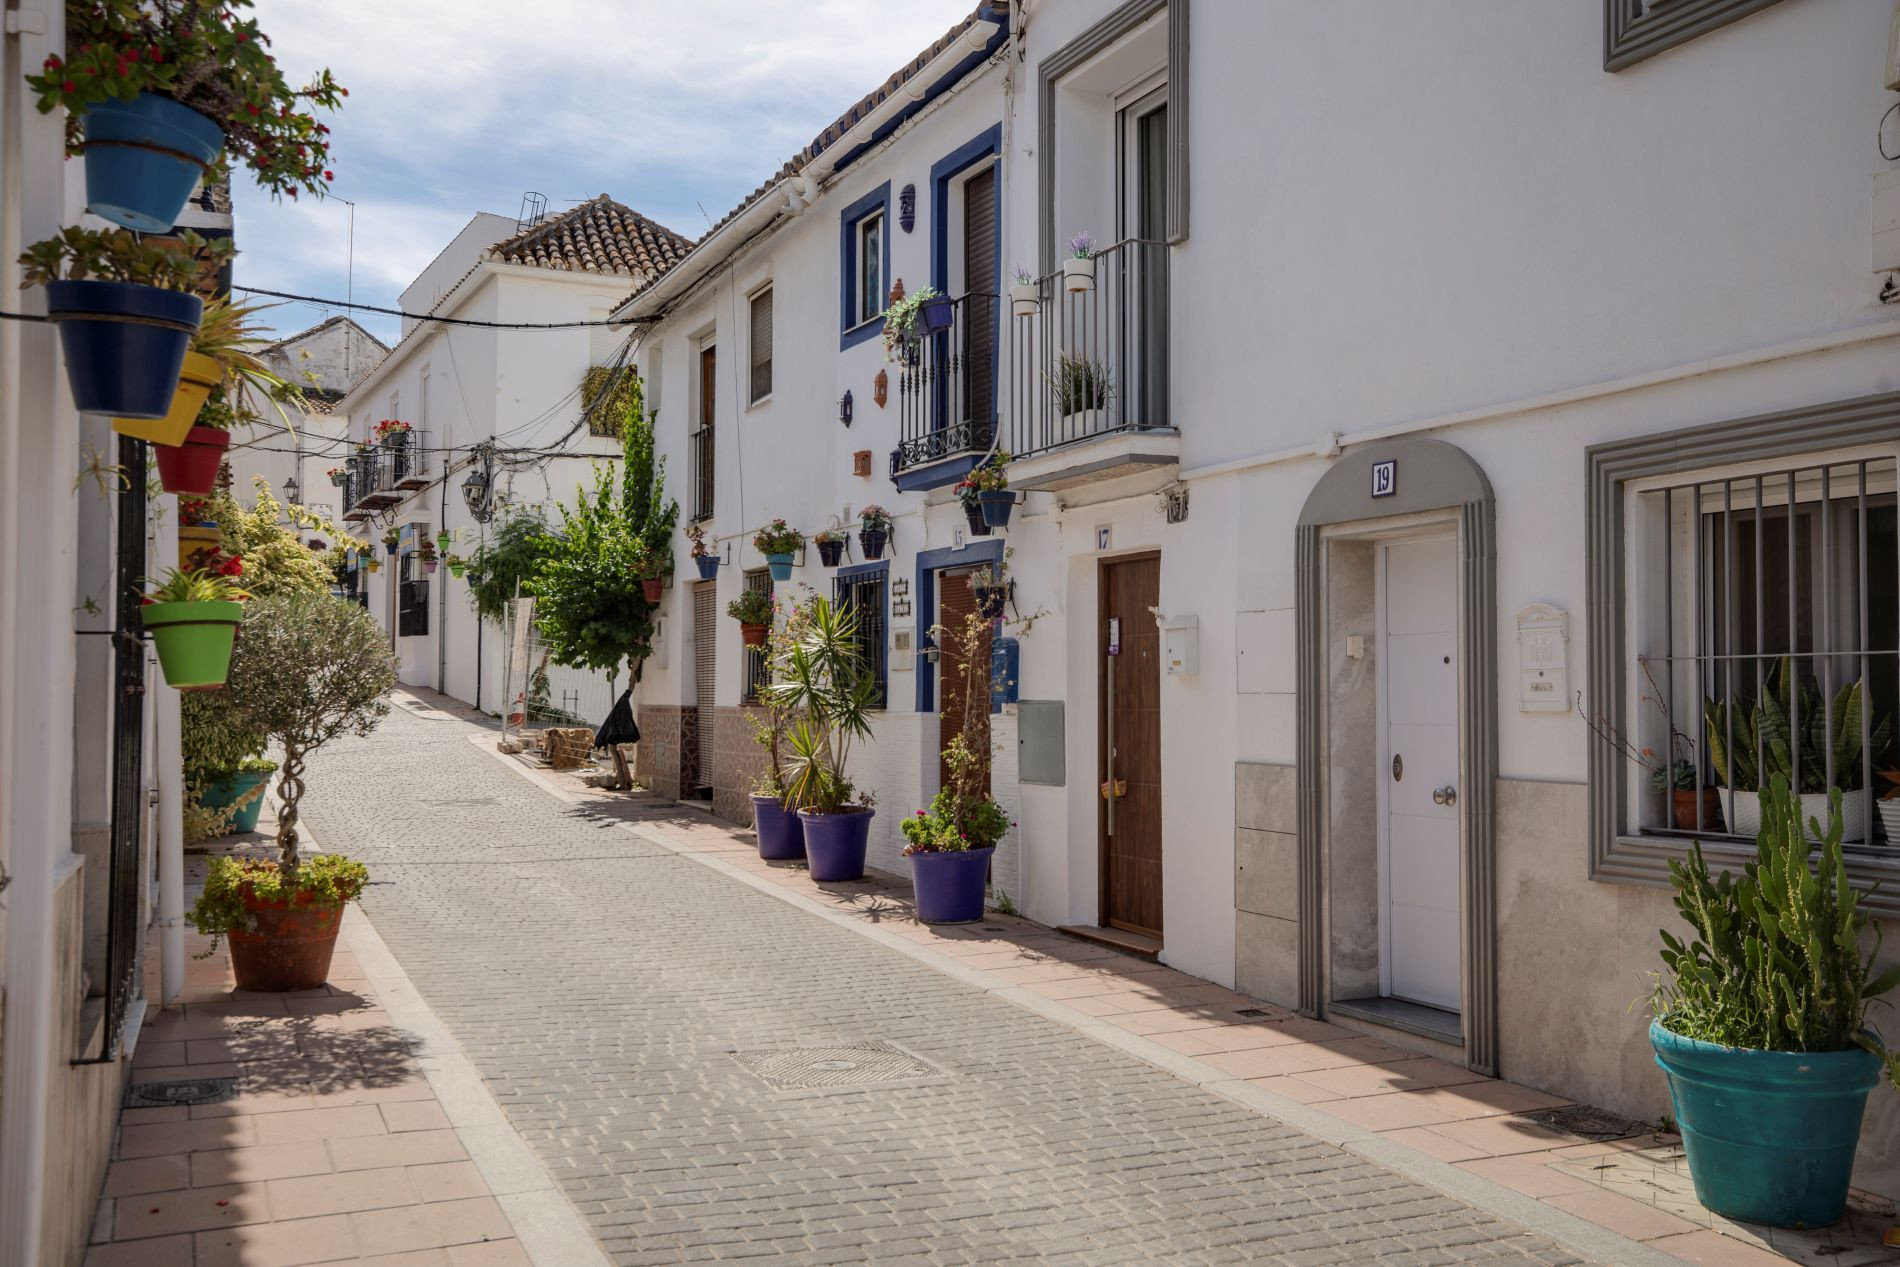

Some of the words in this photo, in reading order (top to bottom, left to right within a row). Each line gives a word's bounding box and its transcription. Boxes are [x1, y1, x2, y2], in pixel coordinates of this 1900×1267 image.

[1376, 466, 1390, 492] 19
[954, 529, 963, 546] 15
[1098, 528, 1109, 549] 17
